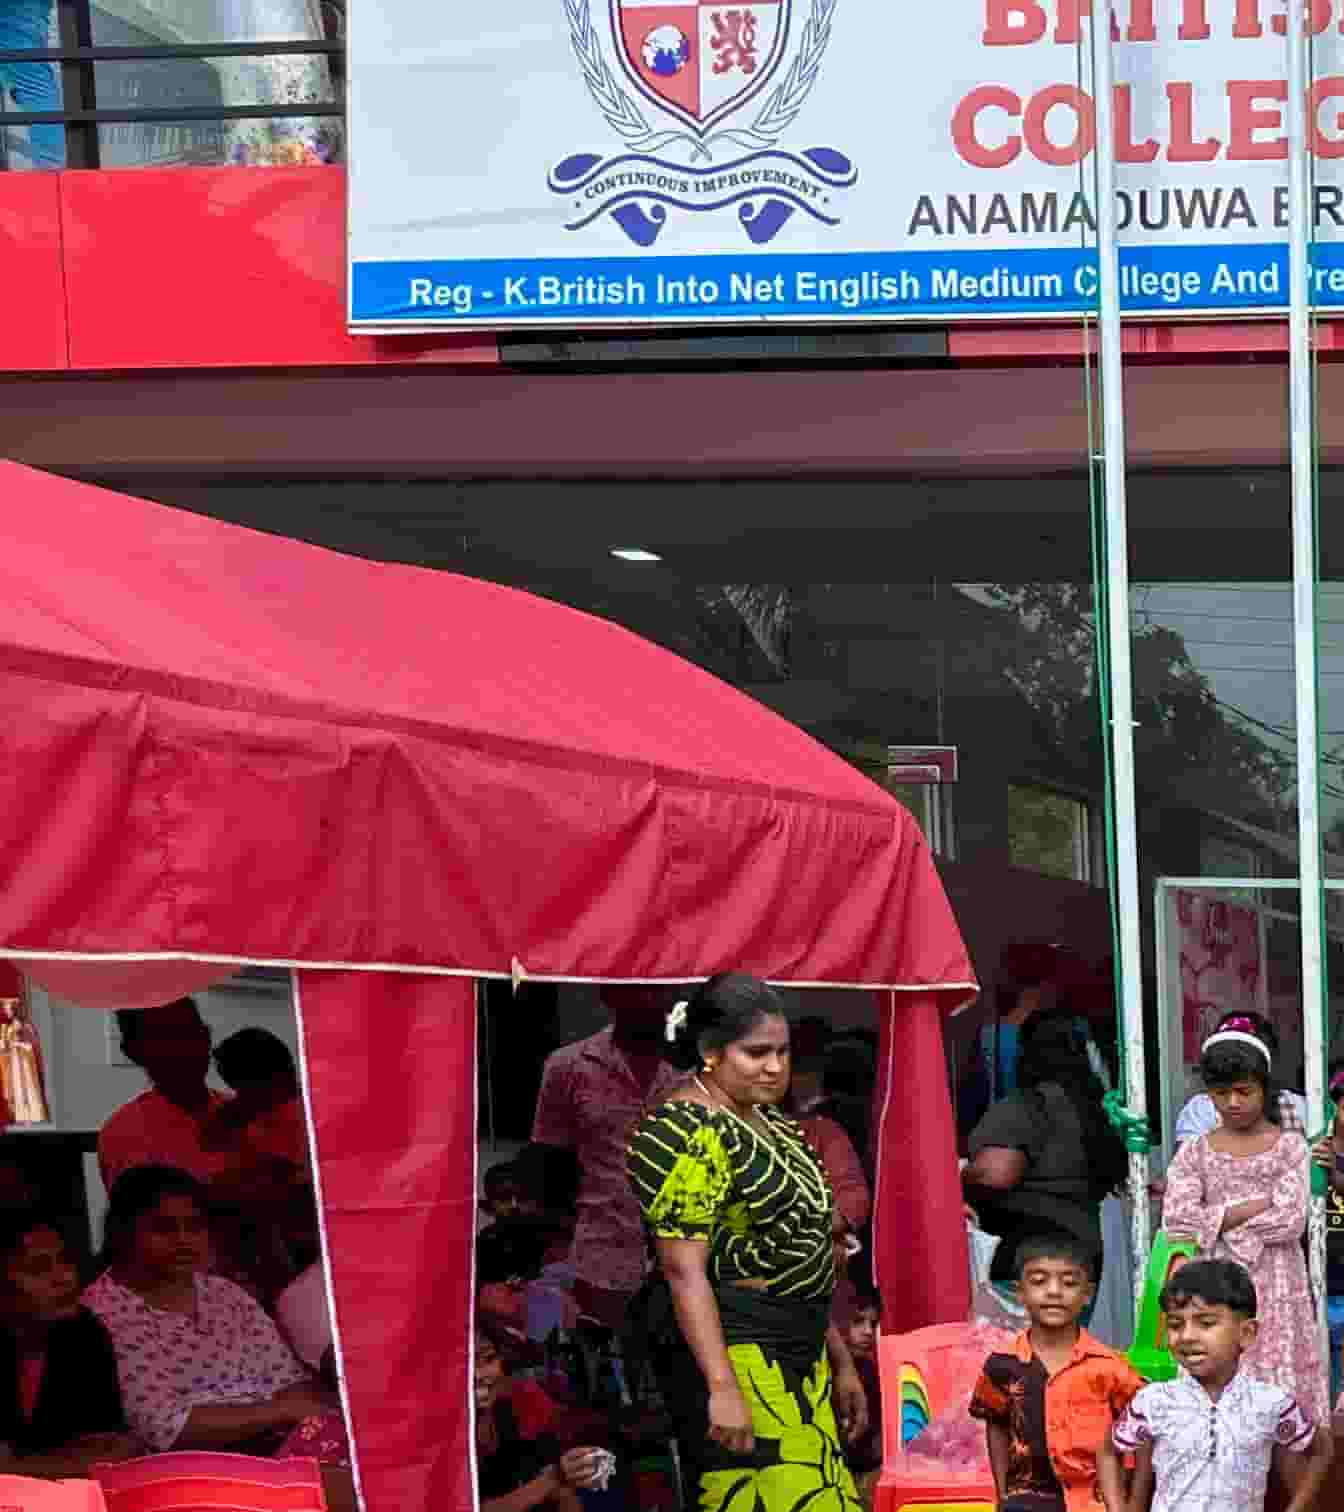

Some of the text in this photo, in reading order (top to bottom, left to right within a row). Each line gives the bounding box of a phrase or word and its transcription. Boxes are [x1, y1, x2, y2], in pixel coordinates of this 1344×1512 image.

[584, 168, 822, 200] CONTINUOUS IMPROVEMENT
[410, 278, 472, 312] Reg
[504, 272, 643, 307] K.British
[656, 271, 720, 304] Into
[729, 269, 787, 302] Net
[796, 267, 922, 308] English
[930, 265, 1064, 300] Medium
[1074, 263, 1201, 303] Cllege
[1210, 262, 1280, 295] And
